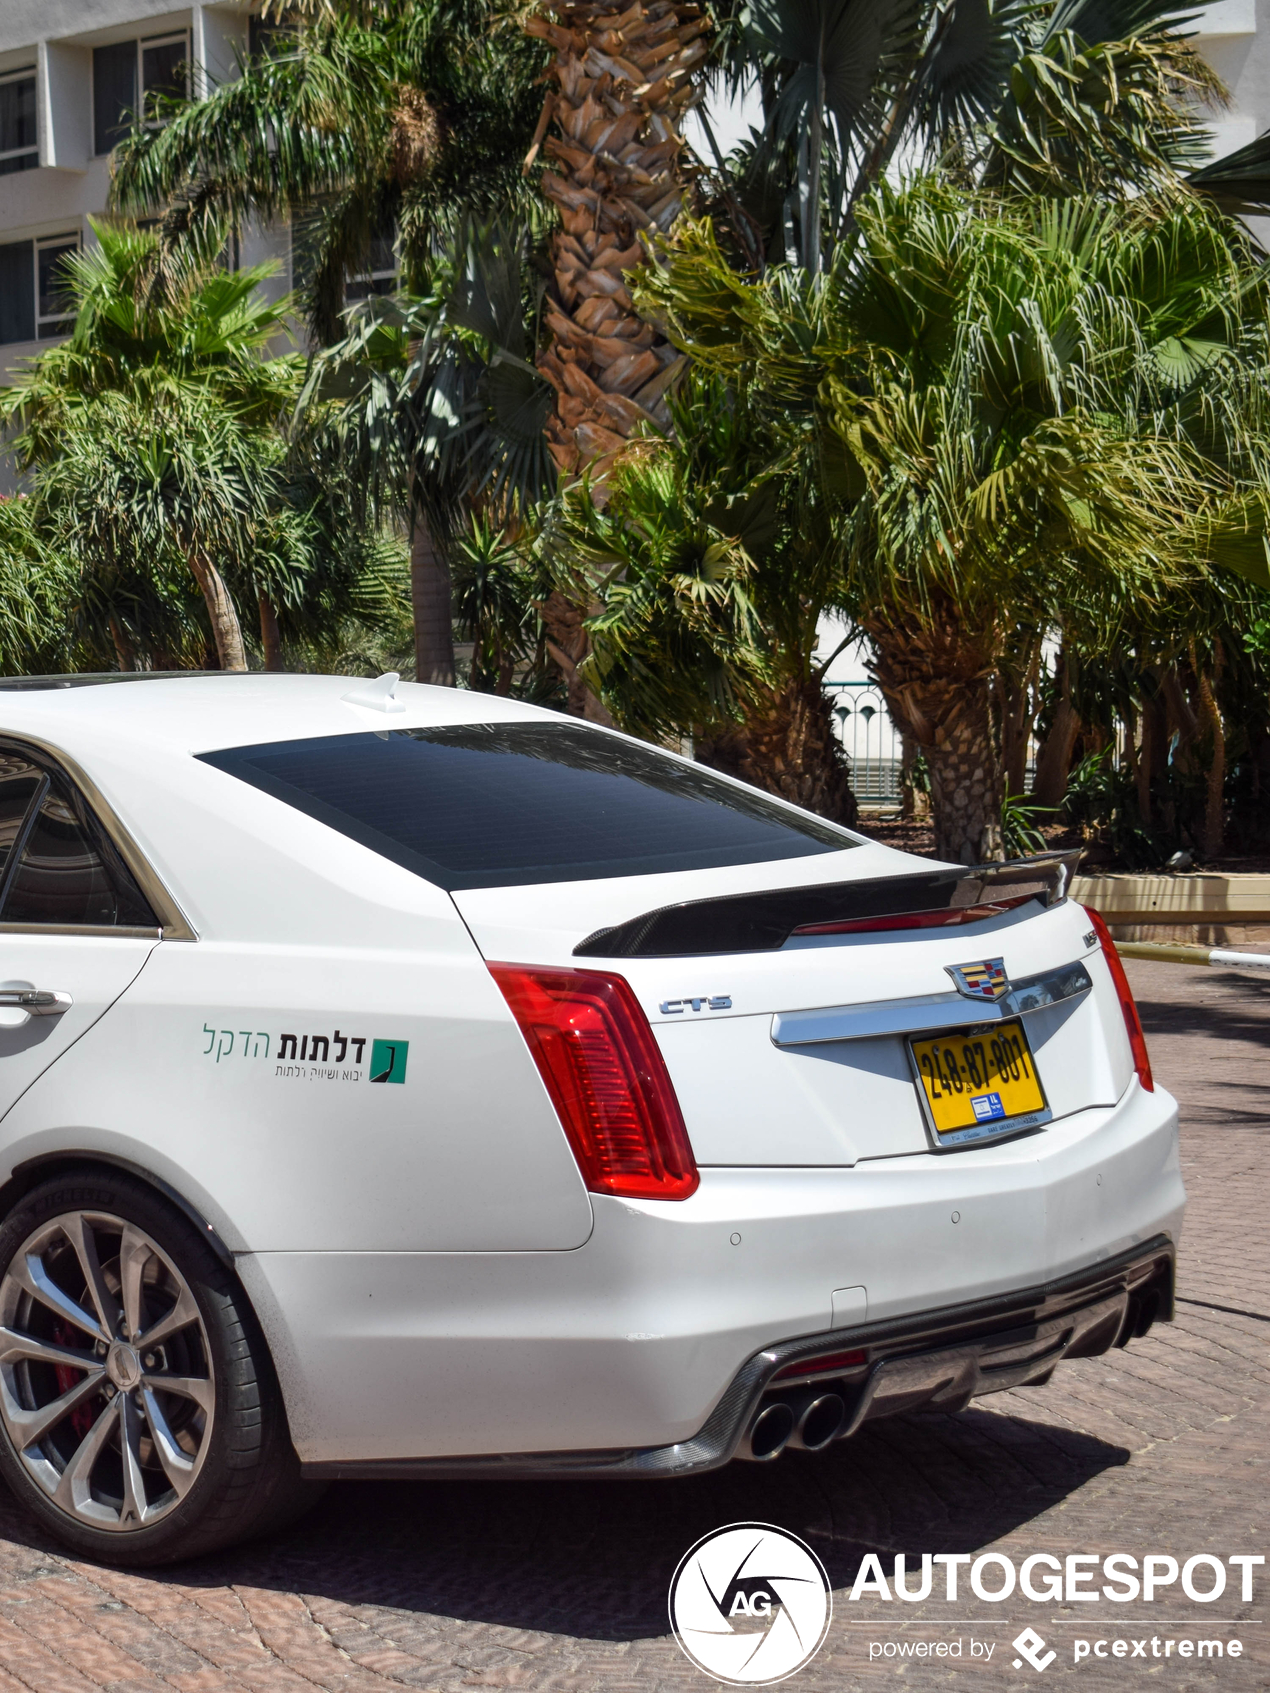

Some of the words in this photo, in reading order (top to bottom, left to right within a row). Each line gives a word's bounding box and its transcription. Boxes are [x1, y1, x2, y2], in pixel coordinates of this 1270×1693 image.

[659, 994, 732, 1014] CTS
[203, 1023, 271, 1063] הדקל
[277, 1030, 367, 1064] דלתות
[342, 1070, 363, 1081] יבוא
[921, 1034, 1030, 1099] 248-87-801
[990, 1094, 999, 1104] IL
[34, 1187, 116, 1210] MICHELIN
